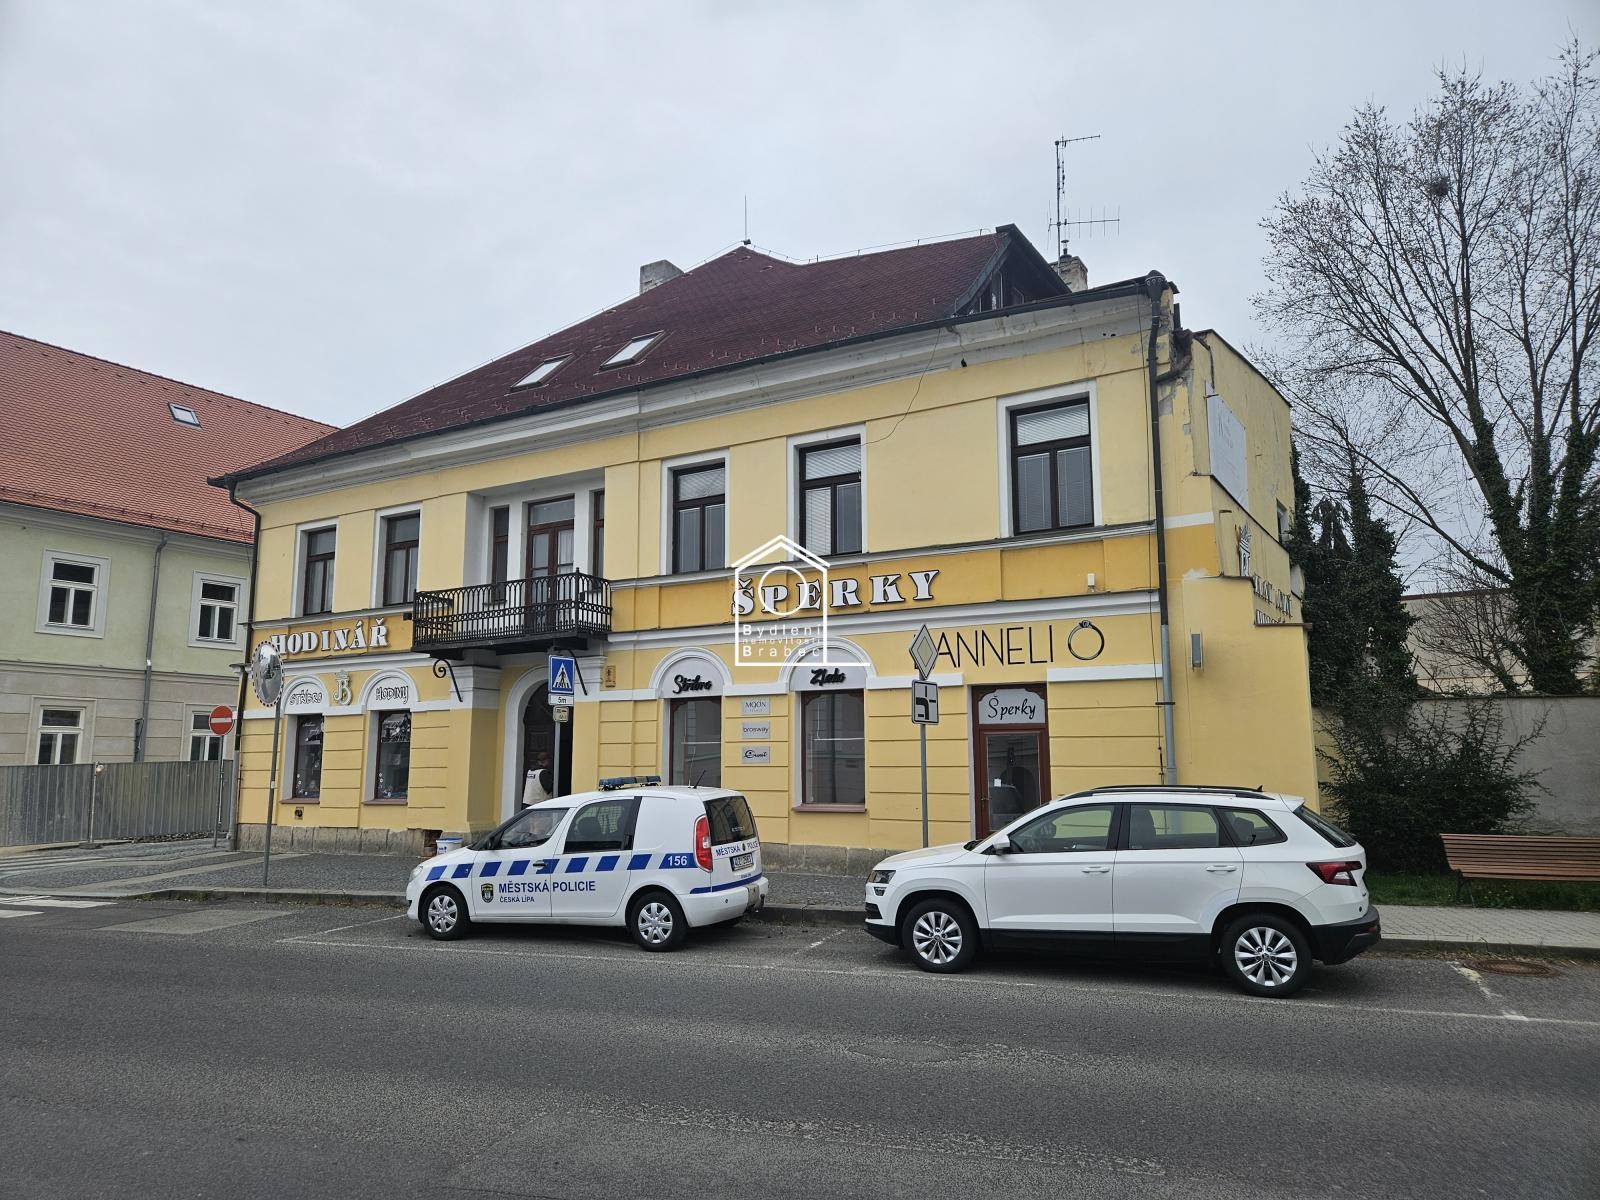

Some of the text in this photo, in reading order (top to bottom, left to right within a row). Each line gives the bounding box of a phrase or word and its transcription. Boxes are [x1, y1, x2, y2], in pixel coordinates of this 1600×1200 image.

[731, 569, 940, 617] ŠPERKY
[271, 617, 389, 655] HODINÁŘ
[375, 685, 410, 705] HODINY
[987, 694, 1036, 721] Šperky
[668, 855, 688, 866] 156
[498, 880, 596, 894] MĚSTSKÁ POLICIE
[499, 895, 535, 903] ČESKÁ LÍPA
